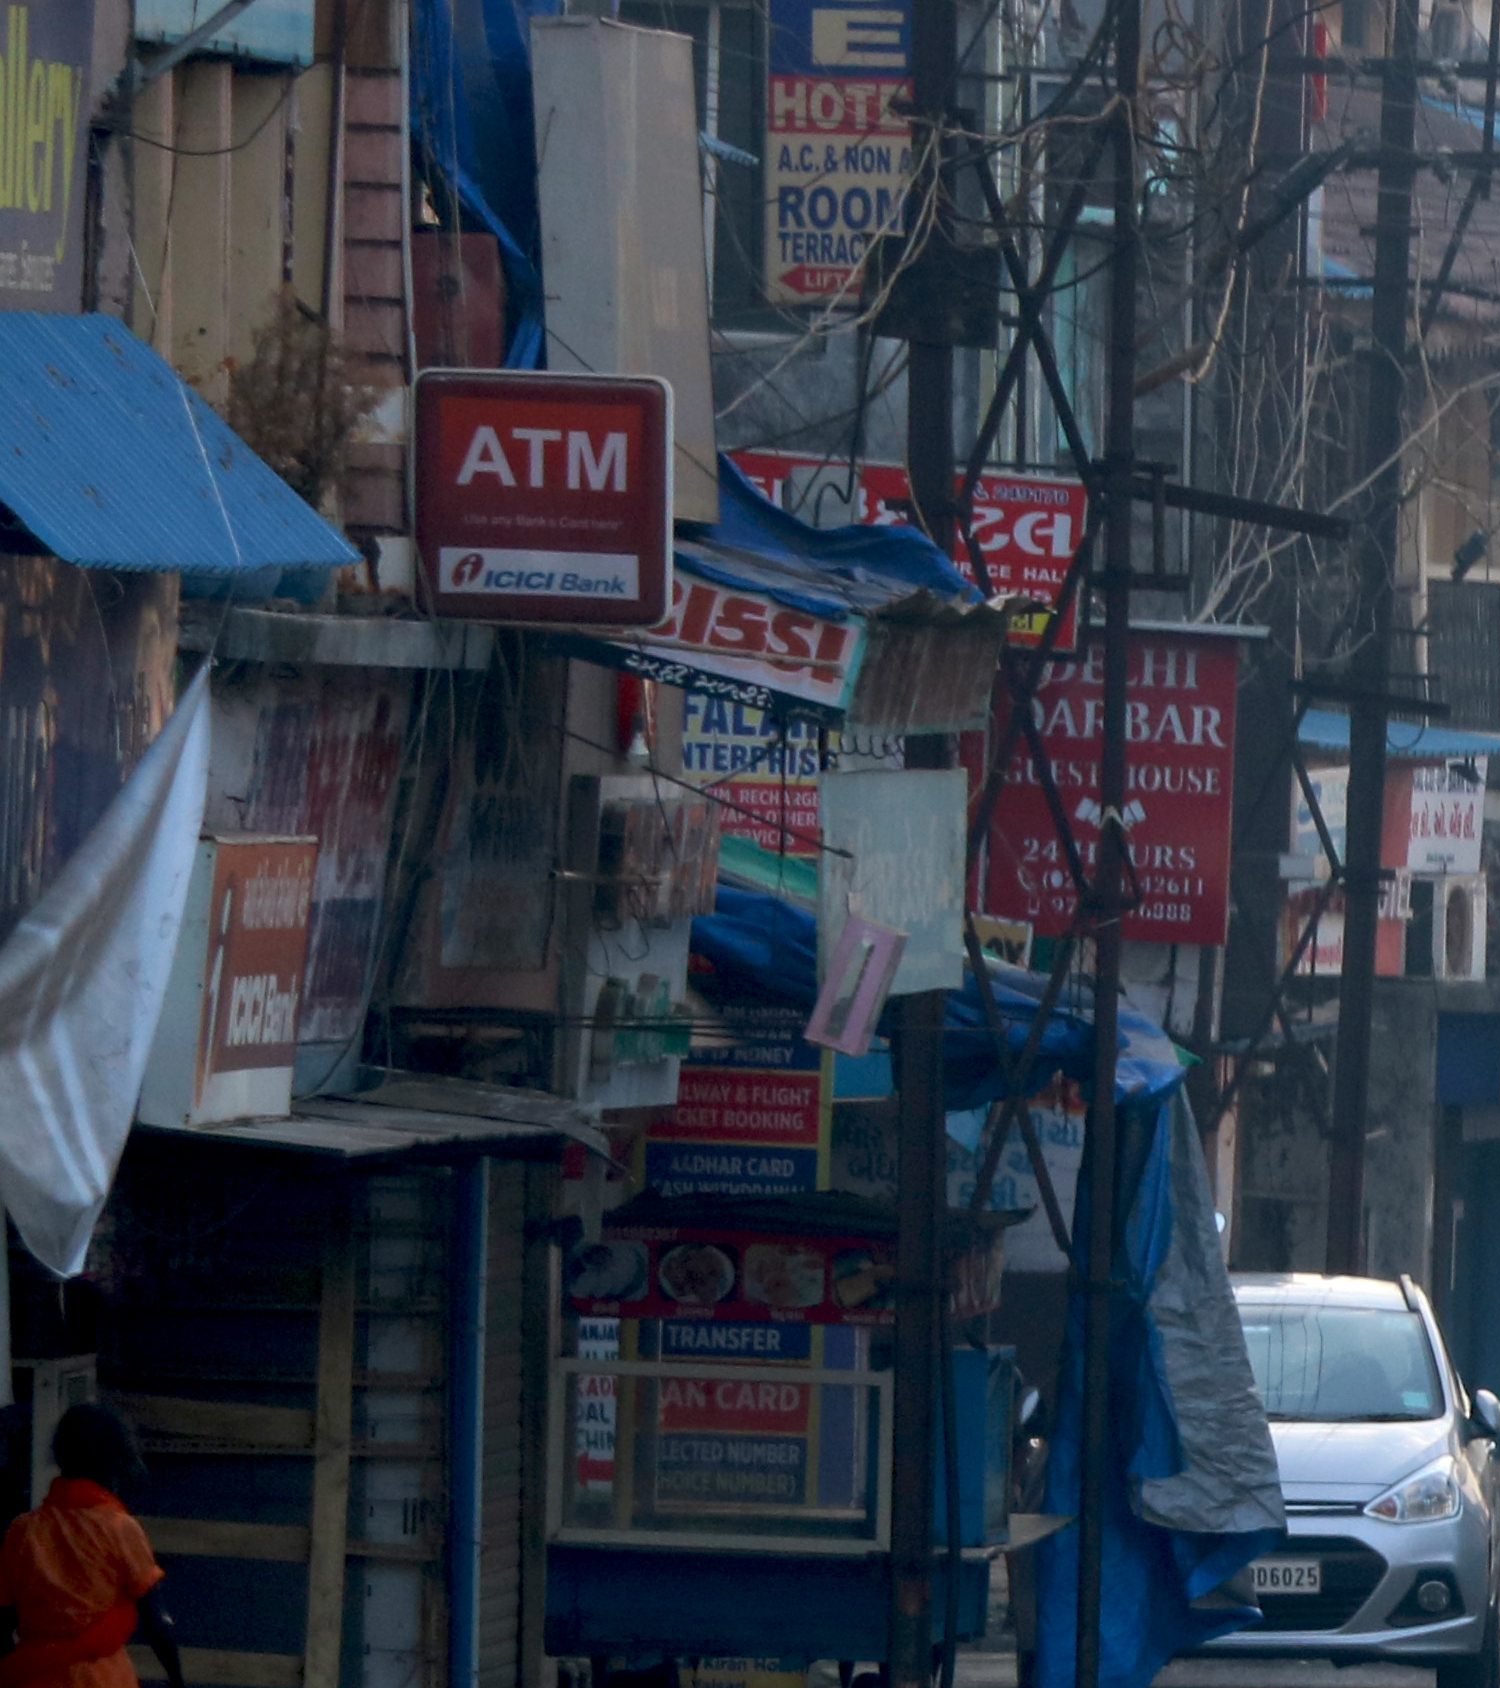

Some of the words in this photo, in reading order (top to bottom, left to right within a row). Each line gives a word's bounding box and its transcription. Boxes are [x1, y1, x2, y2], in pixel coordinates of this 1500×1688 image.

[844, 146, 891, 174] NON
[456, 425, 628, 492] ATM
[484, 570, 554, 589] ICICI
[560, 572, 626, 594] Bank
[1023, 837, 1057, 863] 24
[752, 1086, 812, 1106] FLIGHT
[723, 1110, 805, 1130] BOOKING
[746, 1157, 796, 1178] CARD
[668, 1325, 781, 1350] TRANSFER
[715, 1384, 801, 1413] CARD
[727, 1442, 799, 1466] NUMBER
